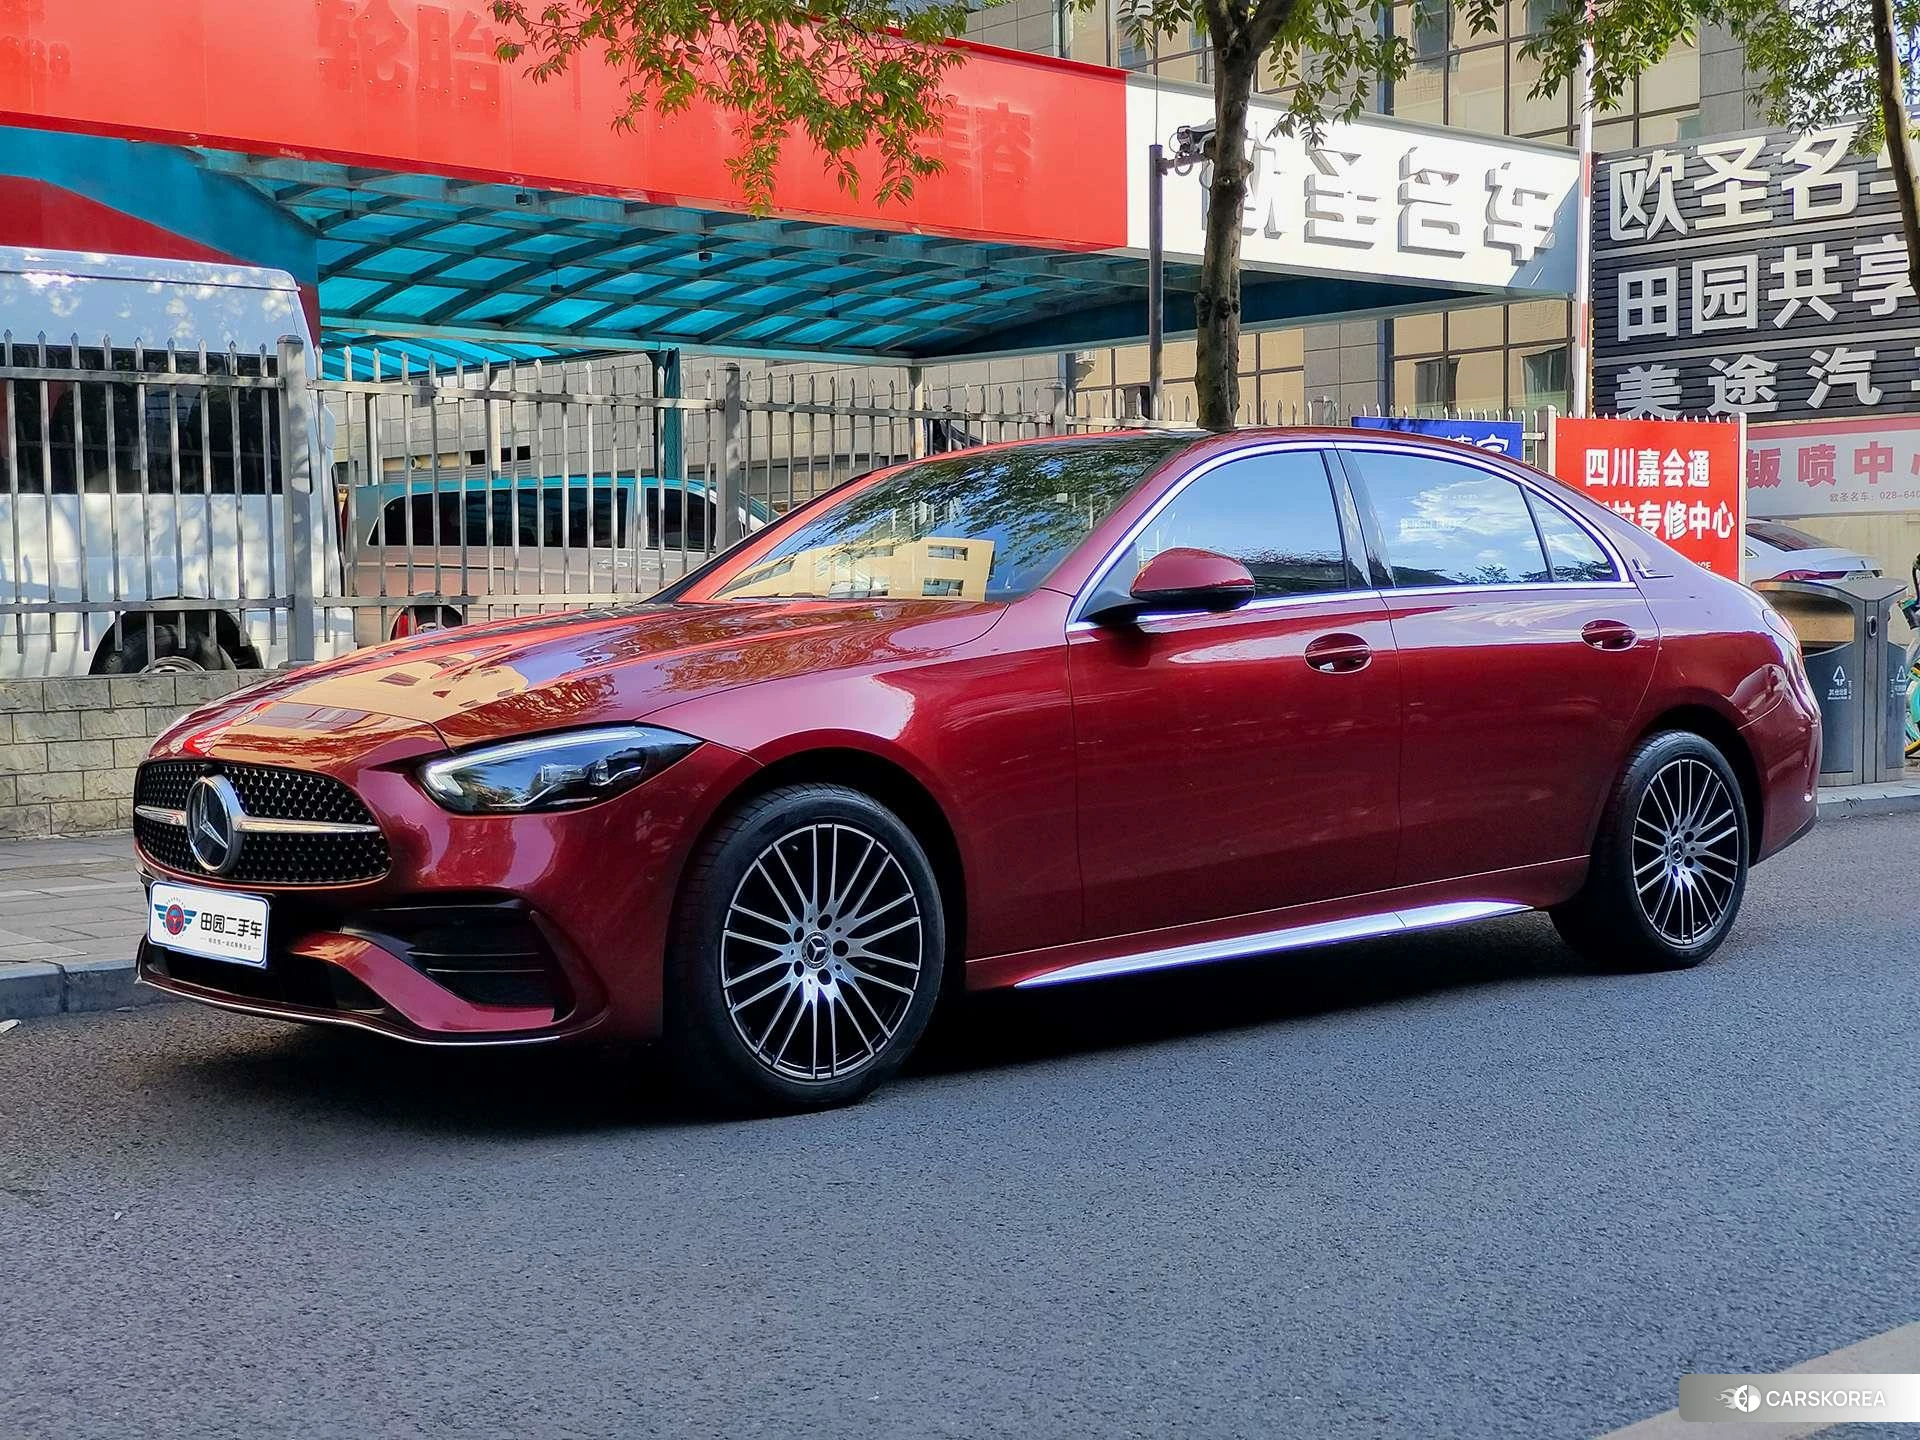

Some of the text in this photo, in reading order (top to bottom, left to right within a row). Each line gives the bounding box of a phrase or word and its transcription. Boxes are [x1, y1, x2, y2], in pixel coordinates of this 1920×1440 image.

[315, 0, 498, 106] 轮胎
[1617, 234, 1919, 341] 田园共享
[1614, 347, 1920, 419] 美途汽
[1585, 448, 1710, 488] 四川嘉会通
[201, 912, 262, 939] 田园二手车
